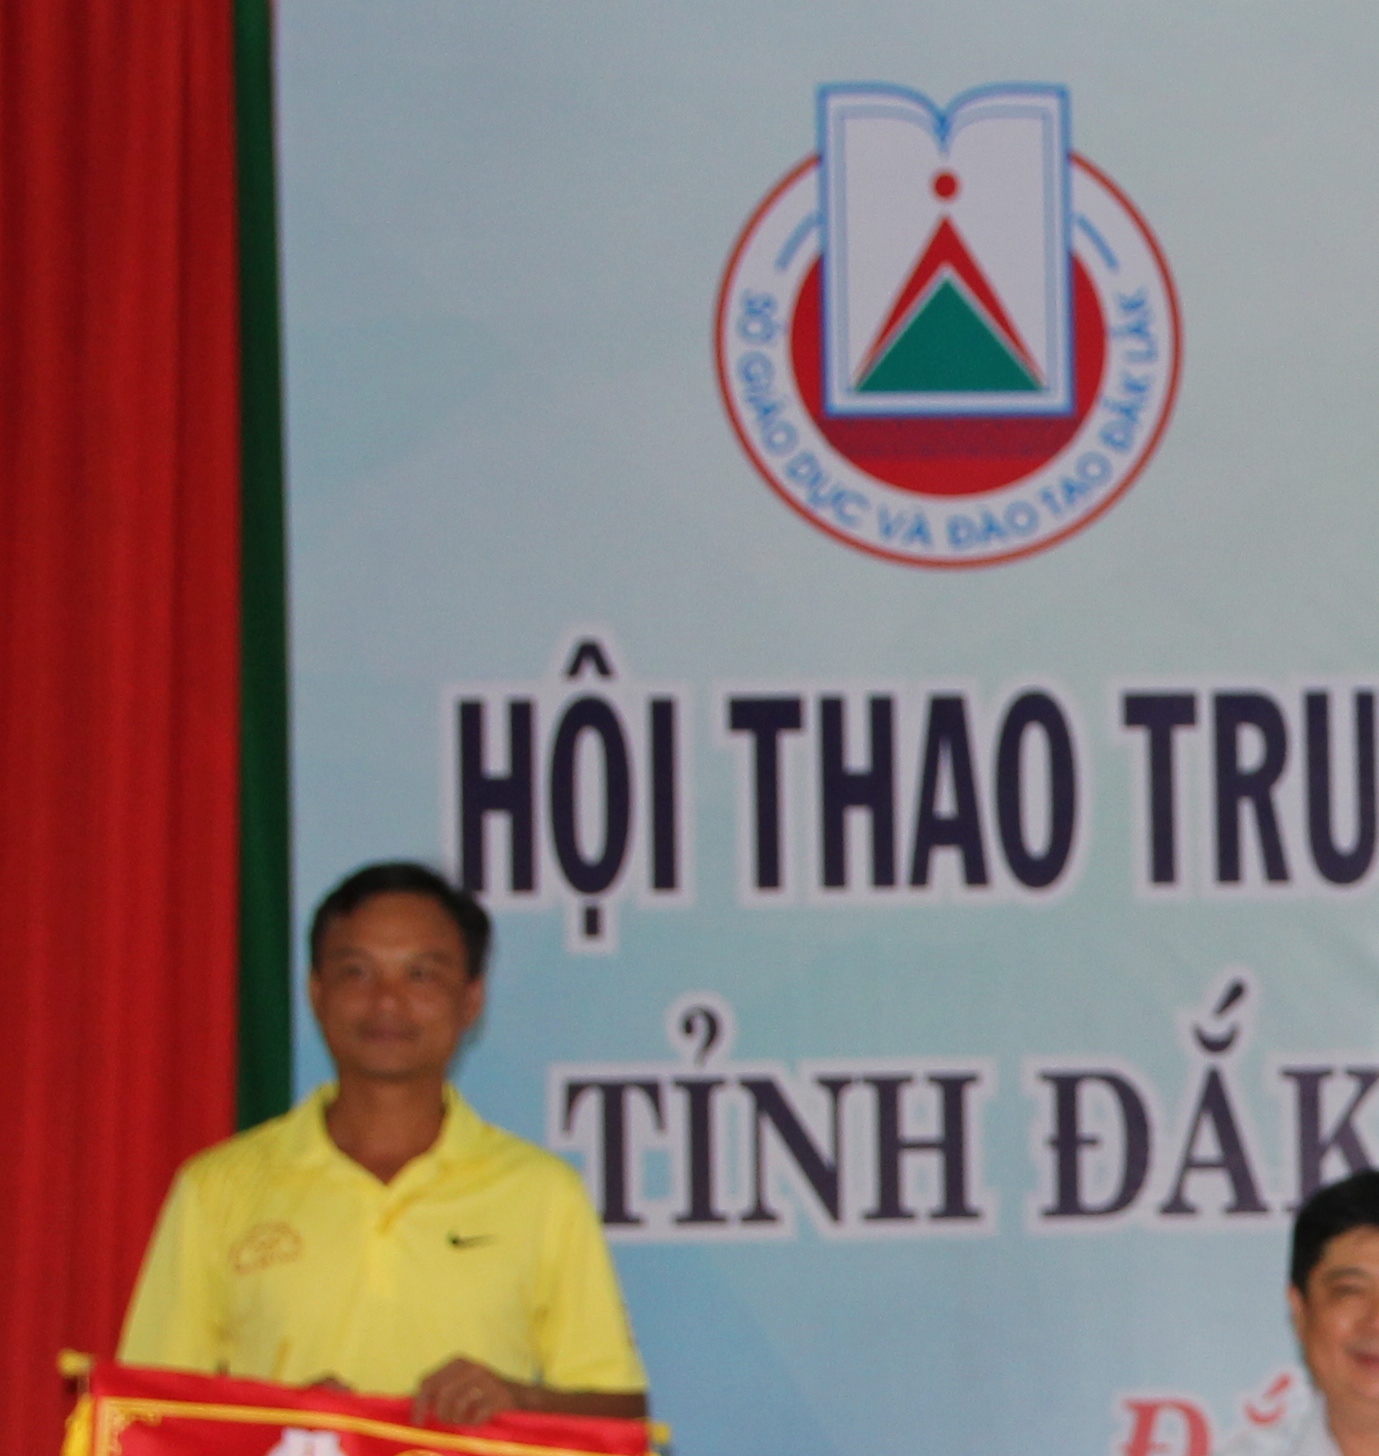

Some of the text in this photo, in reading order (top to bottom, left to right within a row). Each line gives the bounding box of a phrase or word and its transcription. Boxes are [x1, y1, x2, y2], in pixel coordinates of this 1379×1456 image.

[456, 640, 680, 940] HỘI
[727, 687, 1078, 890] THAO
[563, 1005, 985, 1227] TỈNH
